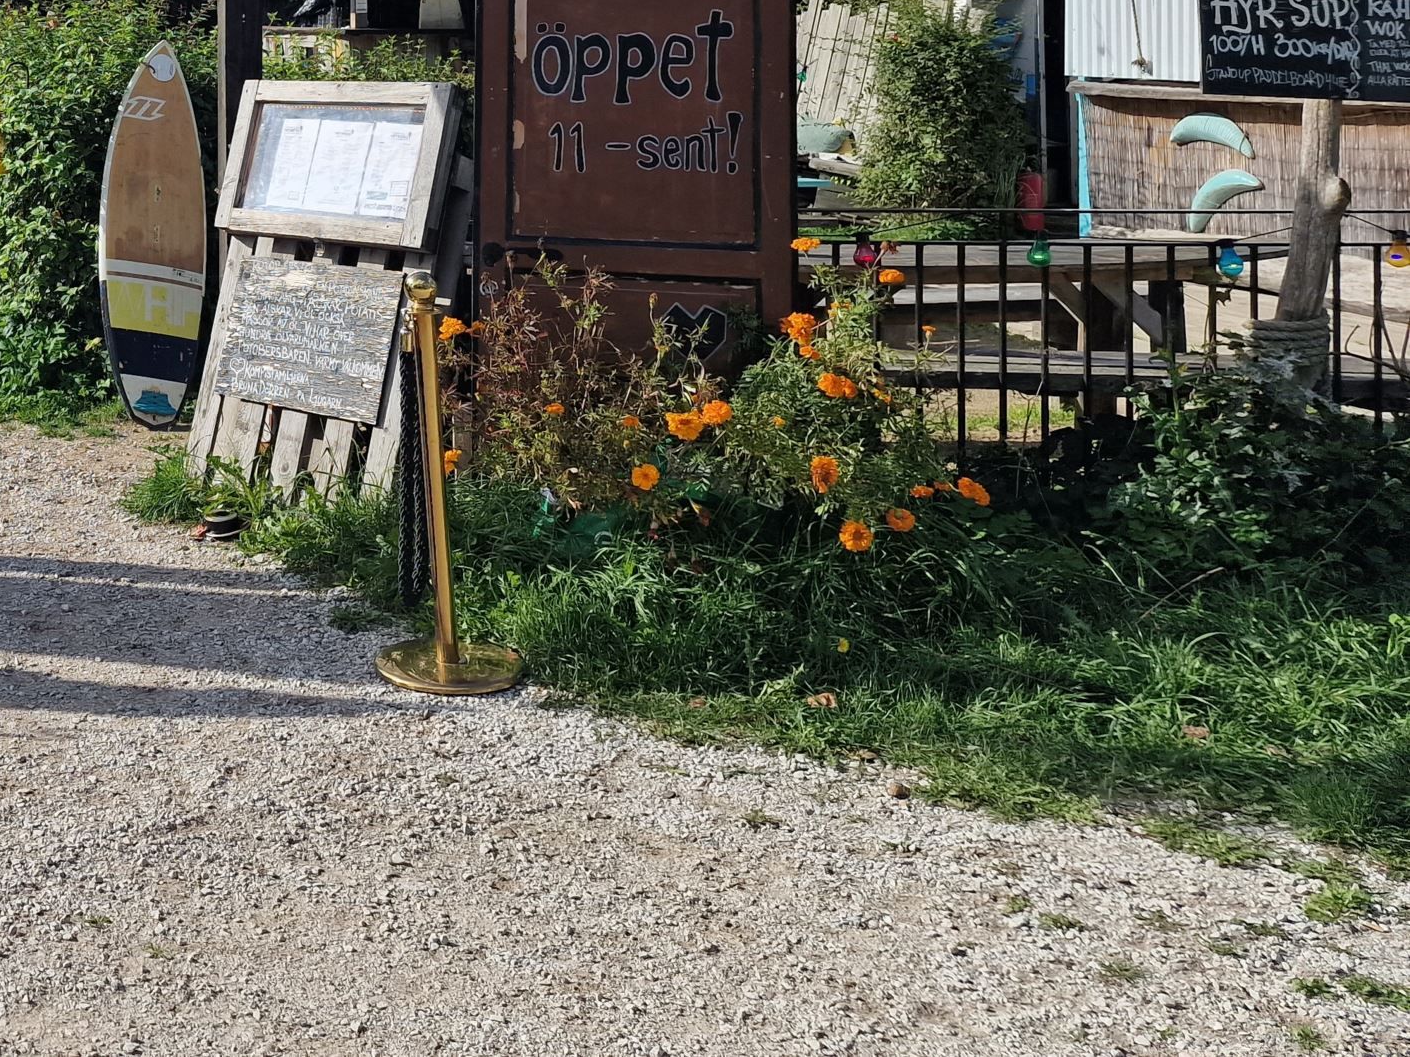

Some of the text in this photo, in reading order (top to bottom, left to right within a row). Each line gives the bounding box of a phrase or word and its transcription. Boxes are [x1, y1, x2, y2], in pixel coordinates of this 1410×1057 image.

[1363, 20, 1406, 39] WOK
[531, 9, 734, 105] öppet
[548, 121, 587, 173] 11
